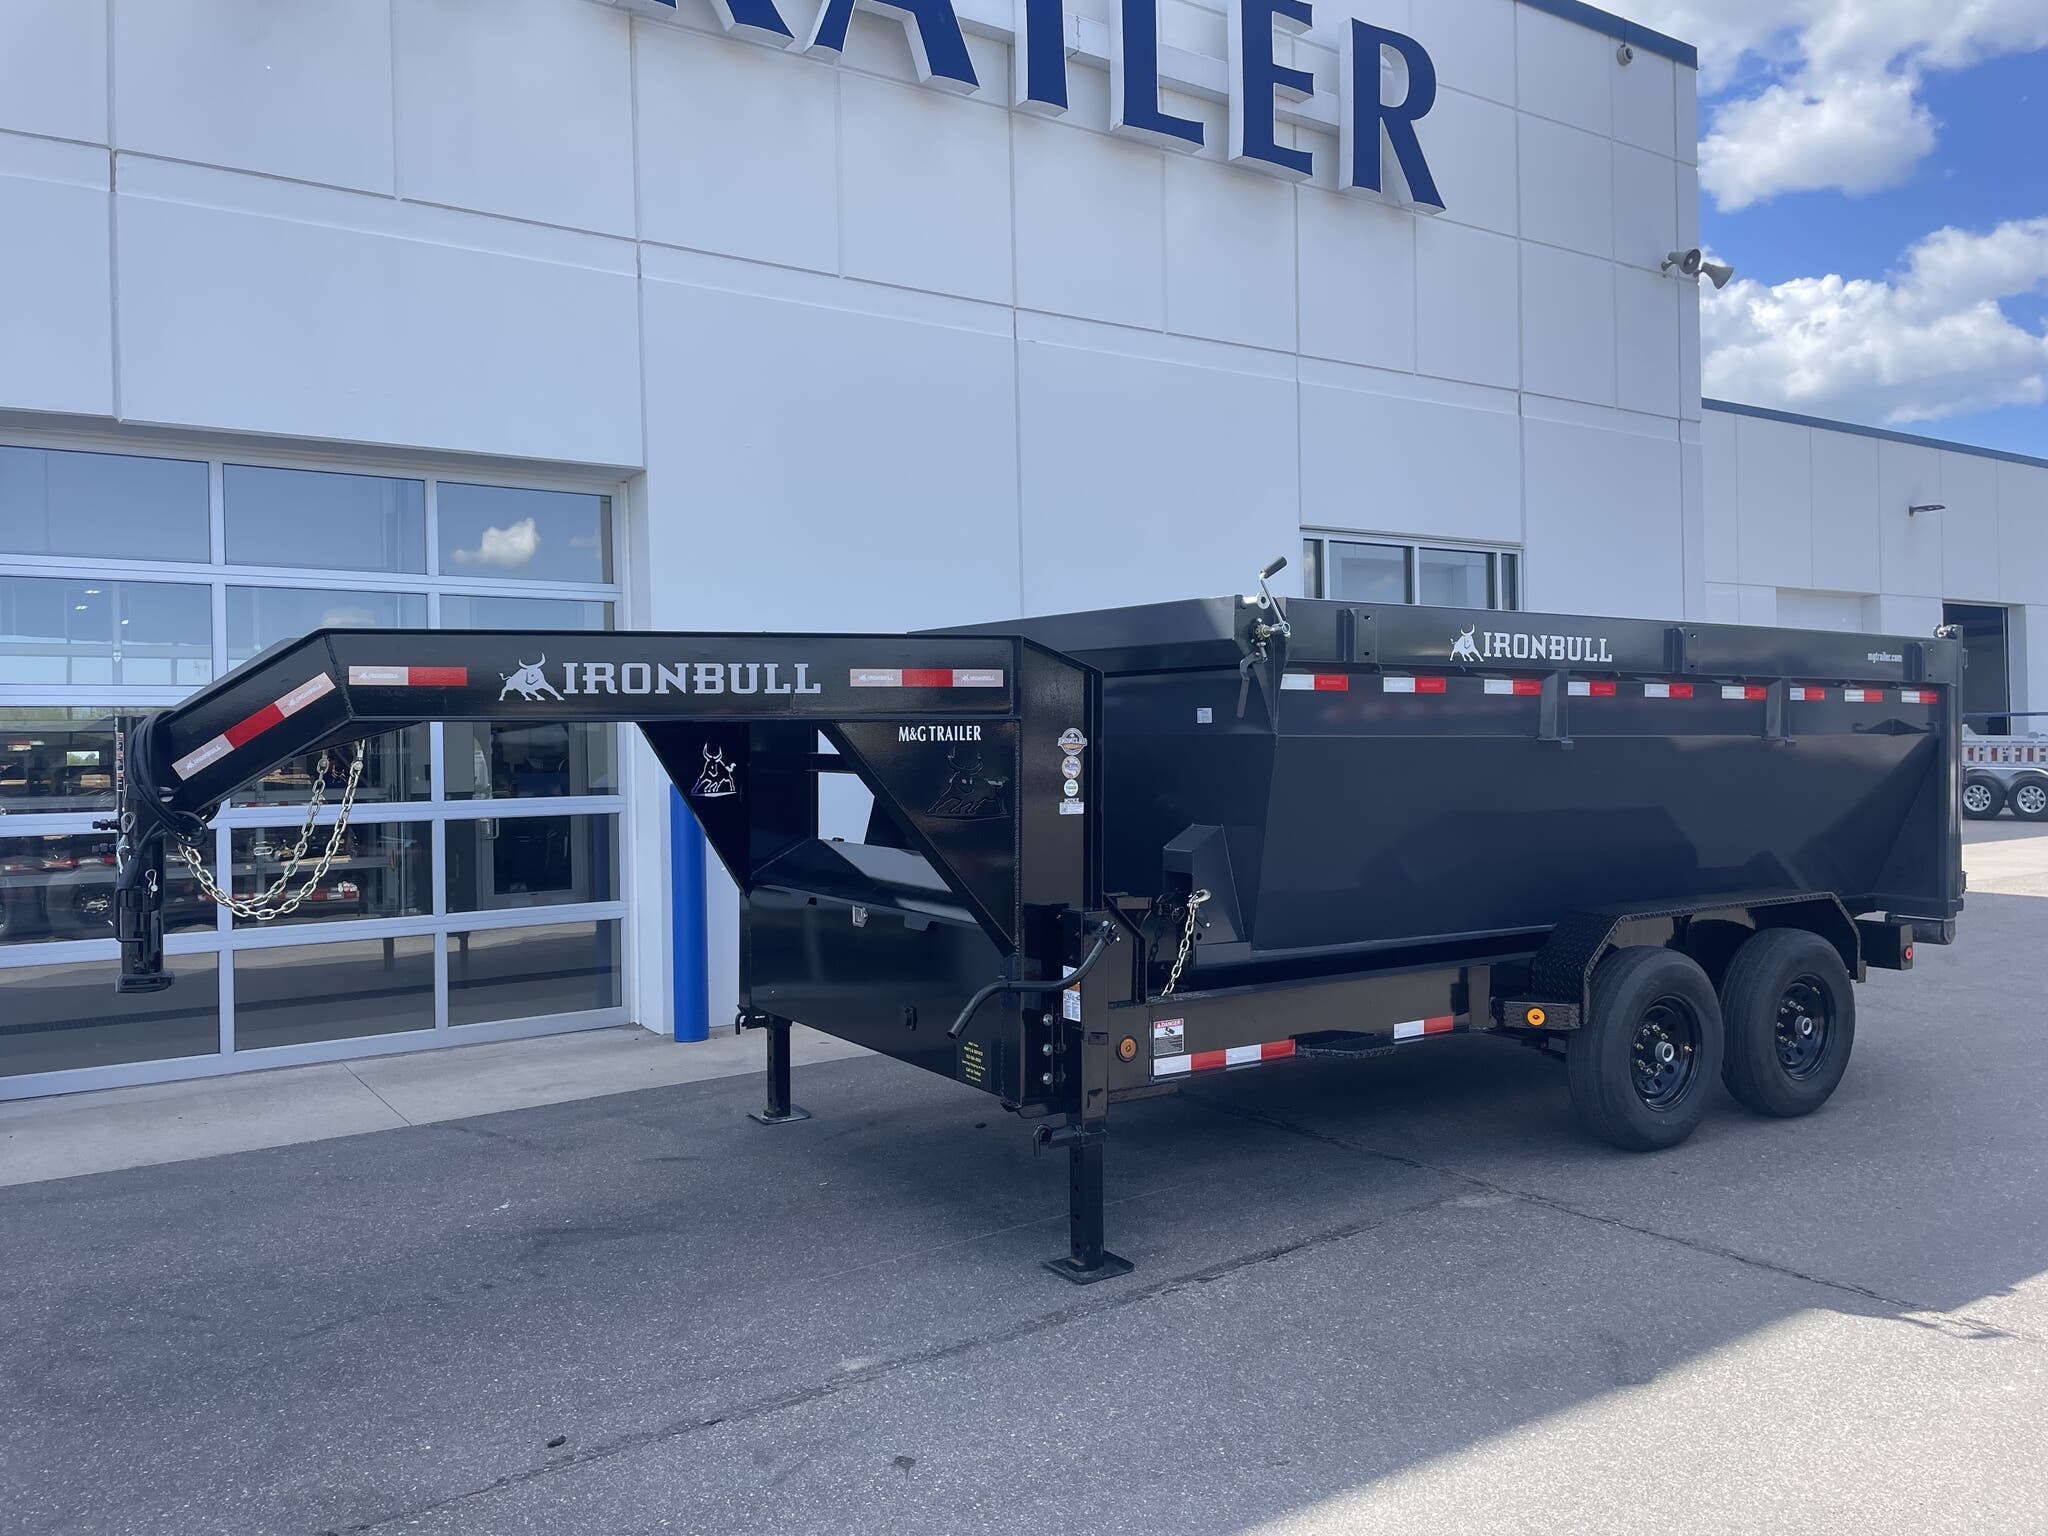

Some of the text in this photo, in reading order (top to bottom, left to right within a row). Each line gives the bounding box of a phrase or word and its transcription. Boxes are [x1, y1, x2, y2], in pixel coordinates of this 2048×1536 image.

[617, 0, 1447, 212] ILER
[1484, 631, 1613, 663] IRONBULL
[563, 662, 821, 694] IRONBULL
[898, 725, 982, 742] M&G TRAILER
